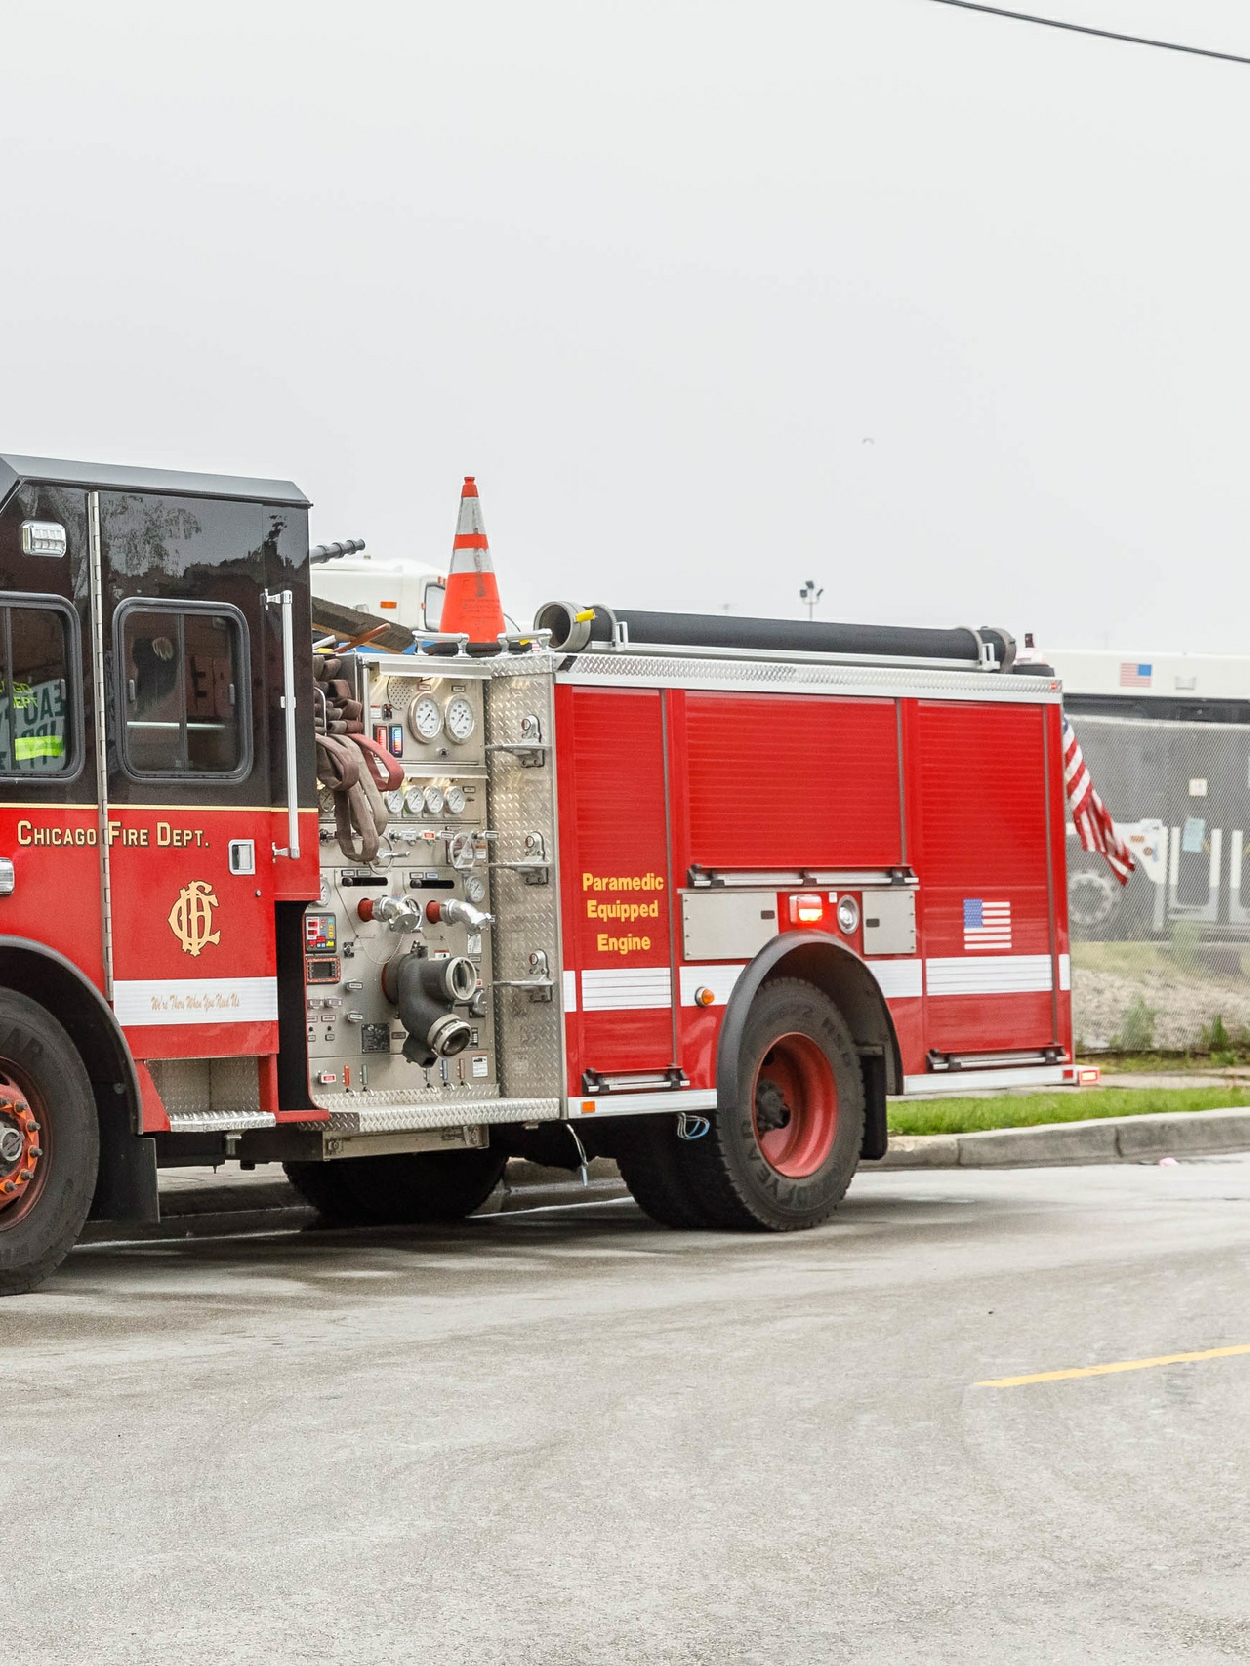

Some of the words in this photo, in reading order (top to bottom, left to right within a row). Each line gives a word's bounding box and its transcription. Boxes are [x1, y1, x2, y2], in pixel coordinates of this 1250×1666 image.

[17, 820, 98, 846] CHICAGO
[108, 821, 149, 846] FIRE
[156, 822, 210, 847] DEPT.
[582, 872, 664, 891] Paramedic
[587, 899, 659, 922] Equipped
[597, 933, 651, 955] Engine
